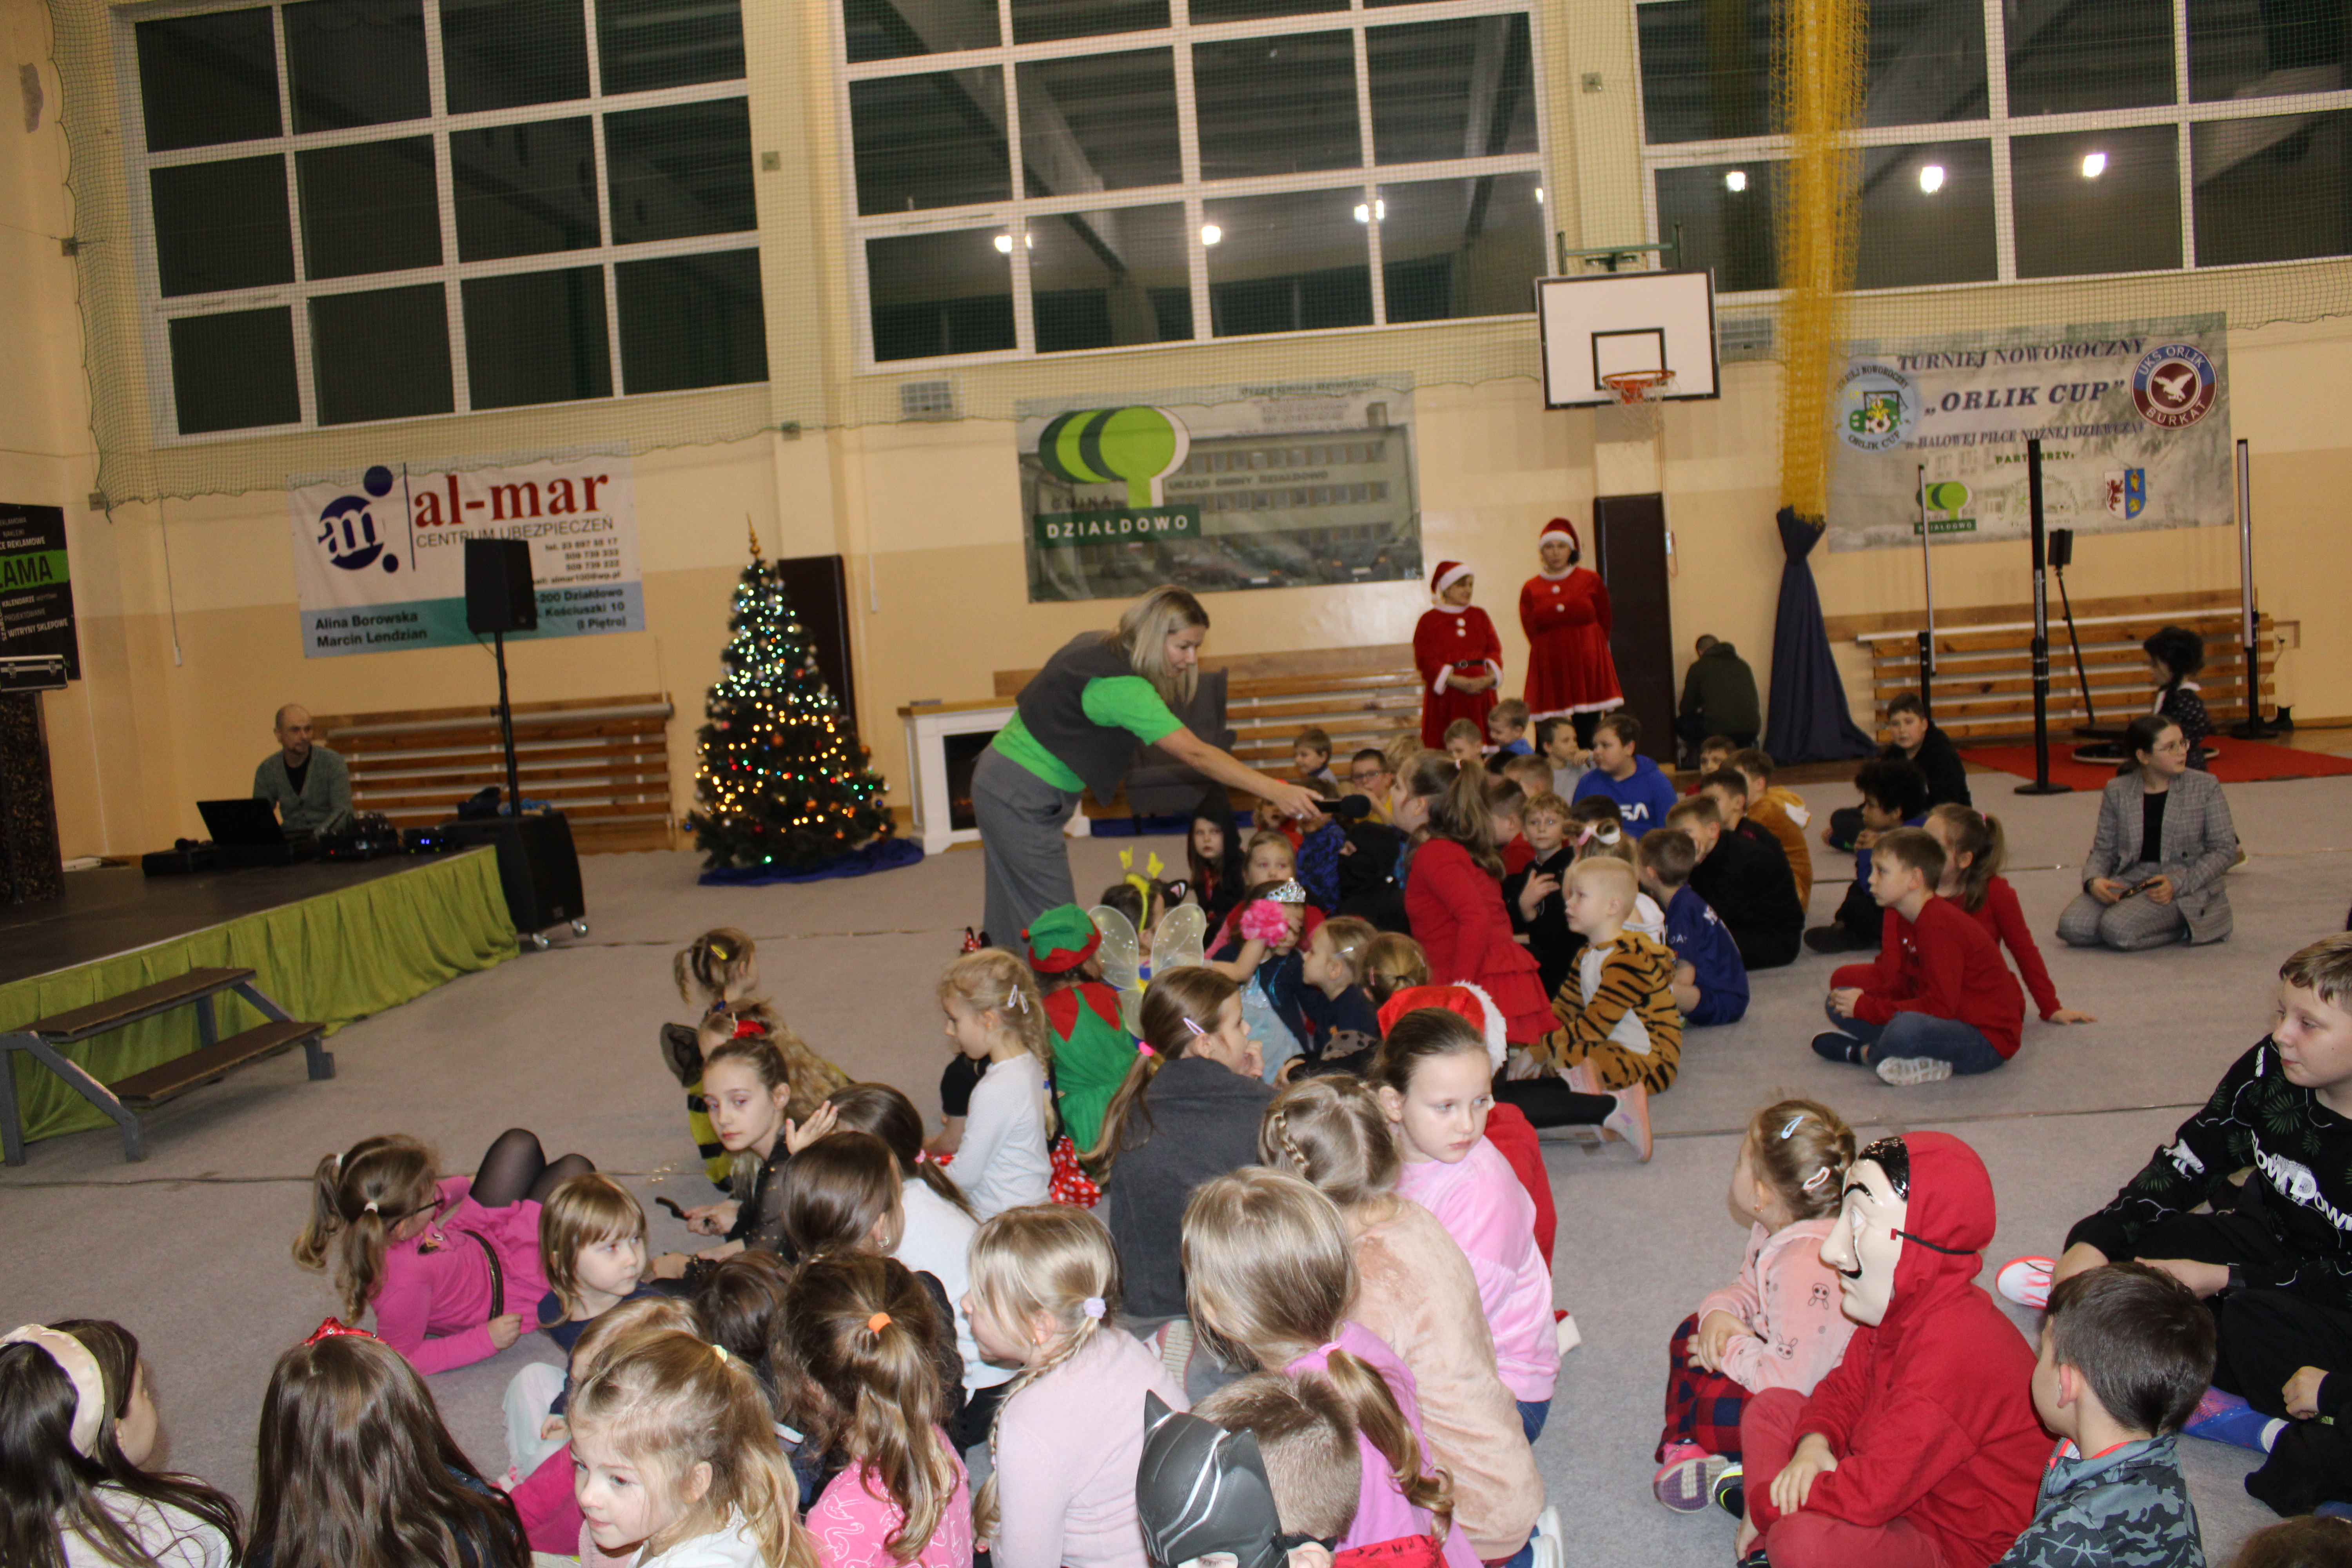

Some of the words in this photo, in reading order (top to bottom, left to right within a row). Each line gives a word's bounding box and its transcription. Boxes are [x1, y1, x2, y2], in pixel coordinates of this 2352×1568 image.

[1897, 351, 1987, 371] TURNIEJ
[1993, 338, 2146, 365] NOWOROCZNY
[2138, 351, 2161, 375] UKS
[2166, 346, 2205, 368] ORLIK
[2146, 400, 2206, 425] BURKAT
[1848, 435, 1878, 449] ORLIK
[1882, 430, 1900, 447] CUP
[1918, 432, 1976, 448] HALOWEJ
[1996, 450, 2074, 464] PARTERZY:
[414, 475, 608, 528] al-mar
[1046, 515, 1188, 539] DZIAŁDOWO
[7, 536, 45, 548] REKLAMOWE
[416, 528, 495, 548] CENTRUM
[0, 555, 53, 588] AMA
[2, 595, 35, 608] KALENDARZE
[564, 589, 624, 601] Działdowo
[4, 608, 46, 622] PROJEKTOWANIE
[545, 603, 607, 616] Kościuszki
[612, 602, 625, 612] 10
[7, 625, 36, 638] WITRYNY
[36, 617, 68, 632] SKLEPOWE
[316, 618, 348, 630] Alina
[352, 611, 418, 627] Borowska
[318, 633, 363, 647] Marcin
[366, 628, 428, 643] Lendzian
[1619, 802, 1650, 821] SA
